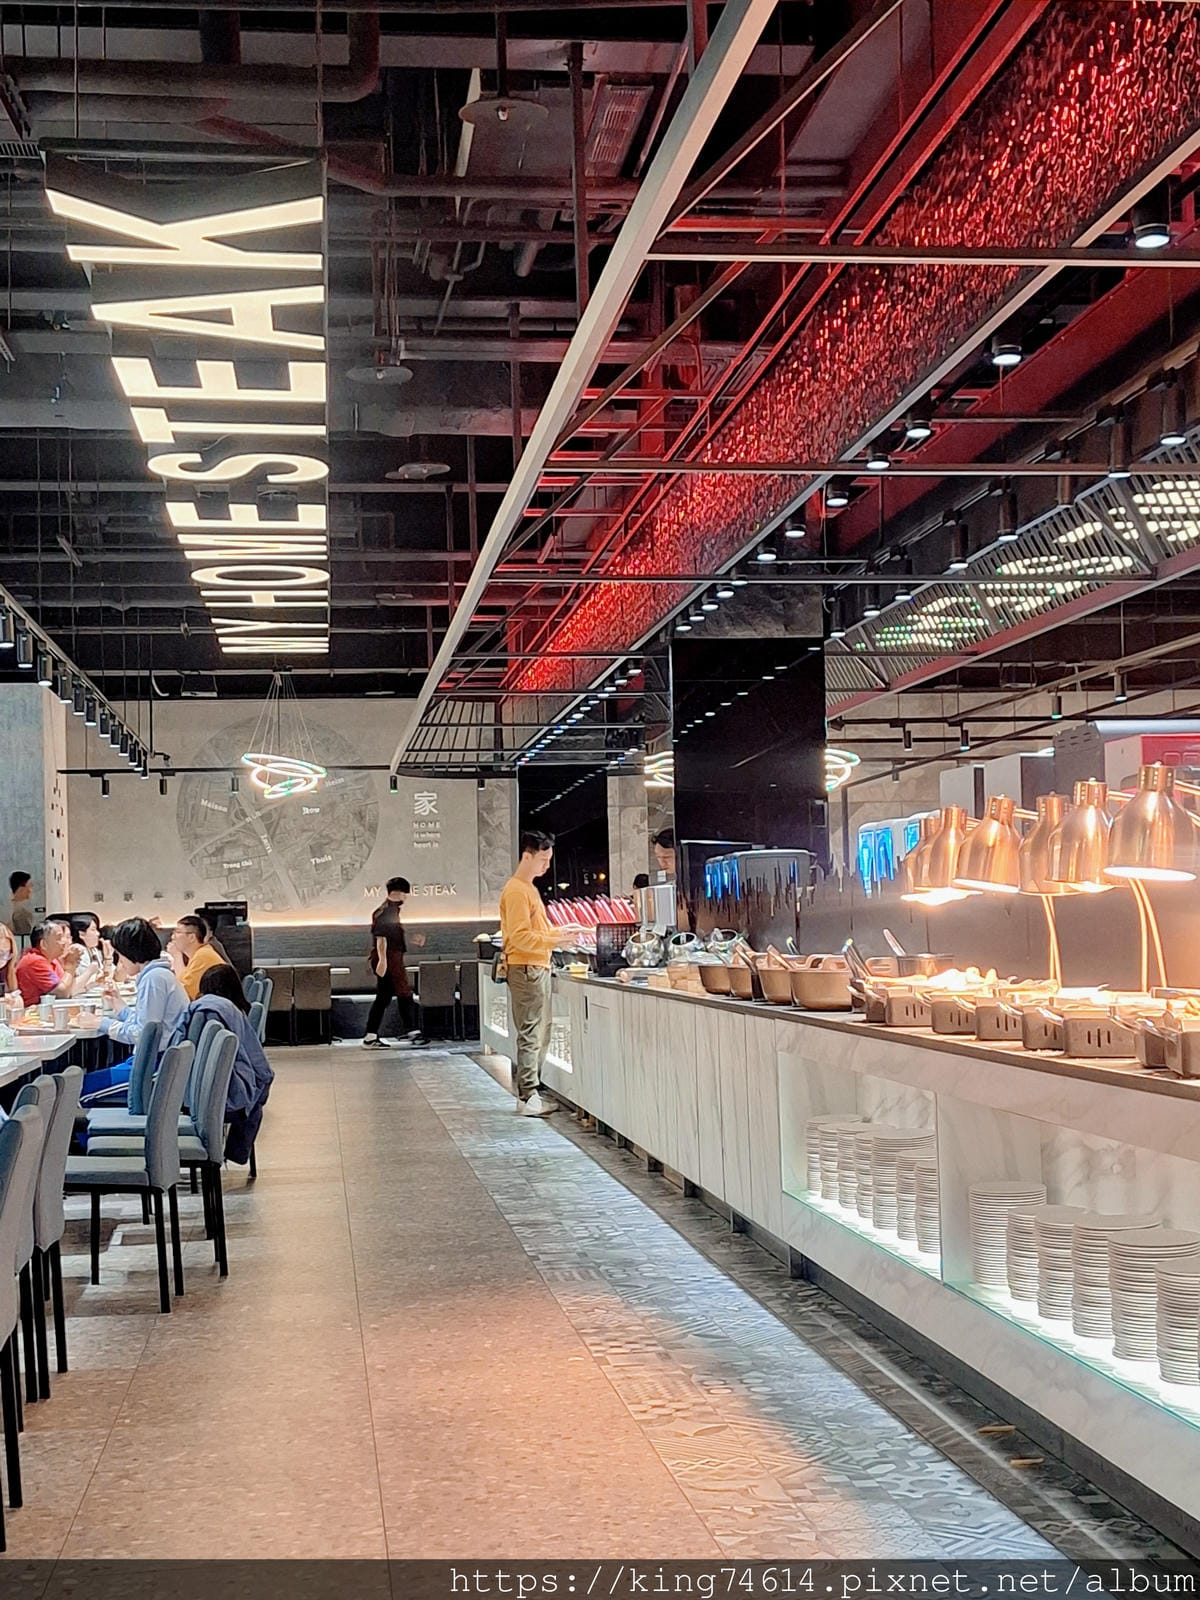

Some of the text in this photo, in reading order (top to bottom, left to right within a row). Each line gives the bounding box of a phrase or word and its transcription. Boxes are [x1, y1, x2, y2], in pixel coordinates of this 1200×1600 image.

[46, 188, 330, 653] MY HOME STEAK
[414, 791, 439, 815] 家
[413, 821, 440, 829] HOME
[364, 885, 381, 897] MY
[423, 883, 457, 897] STEAK
